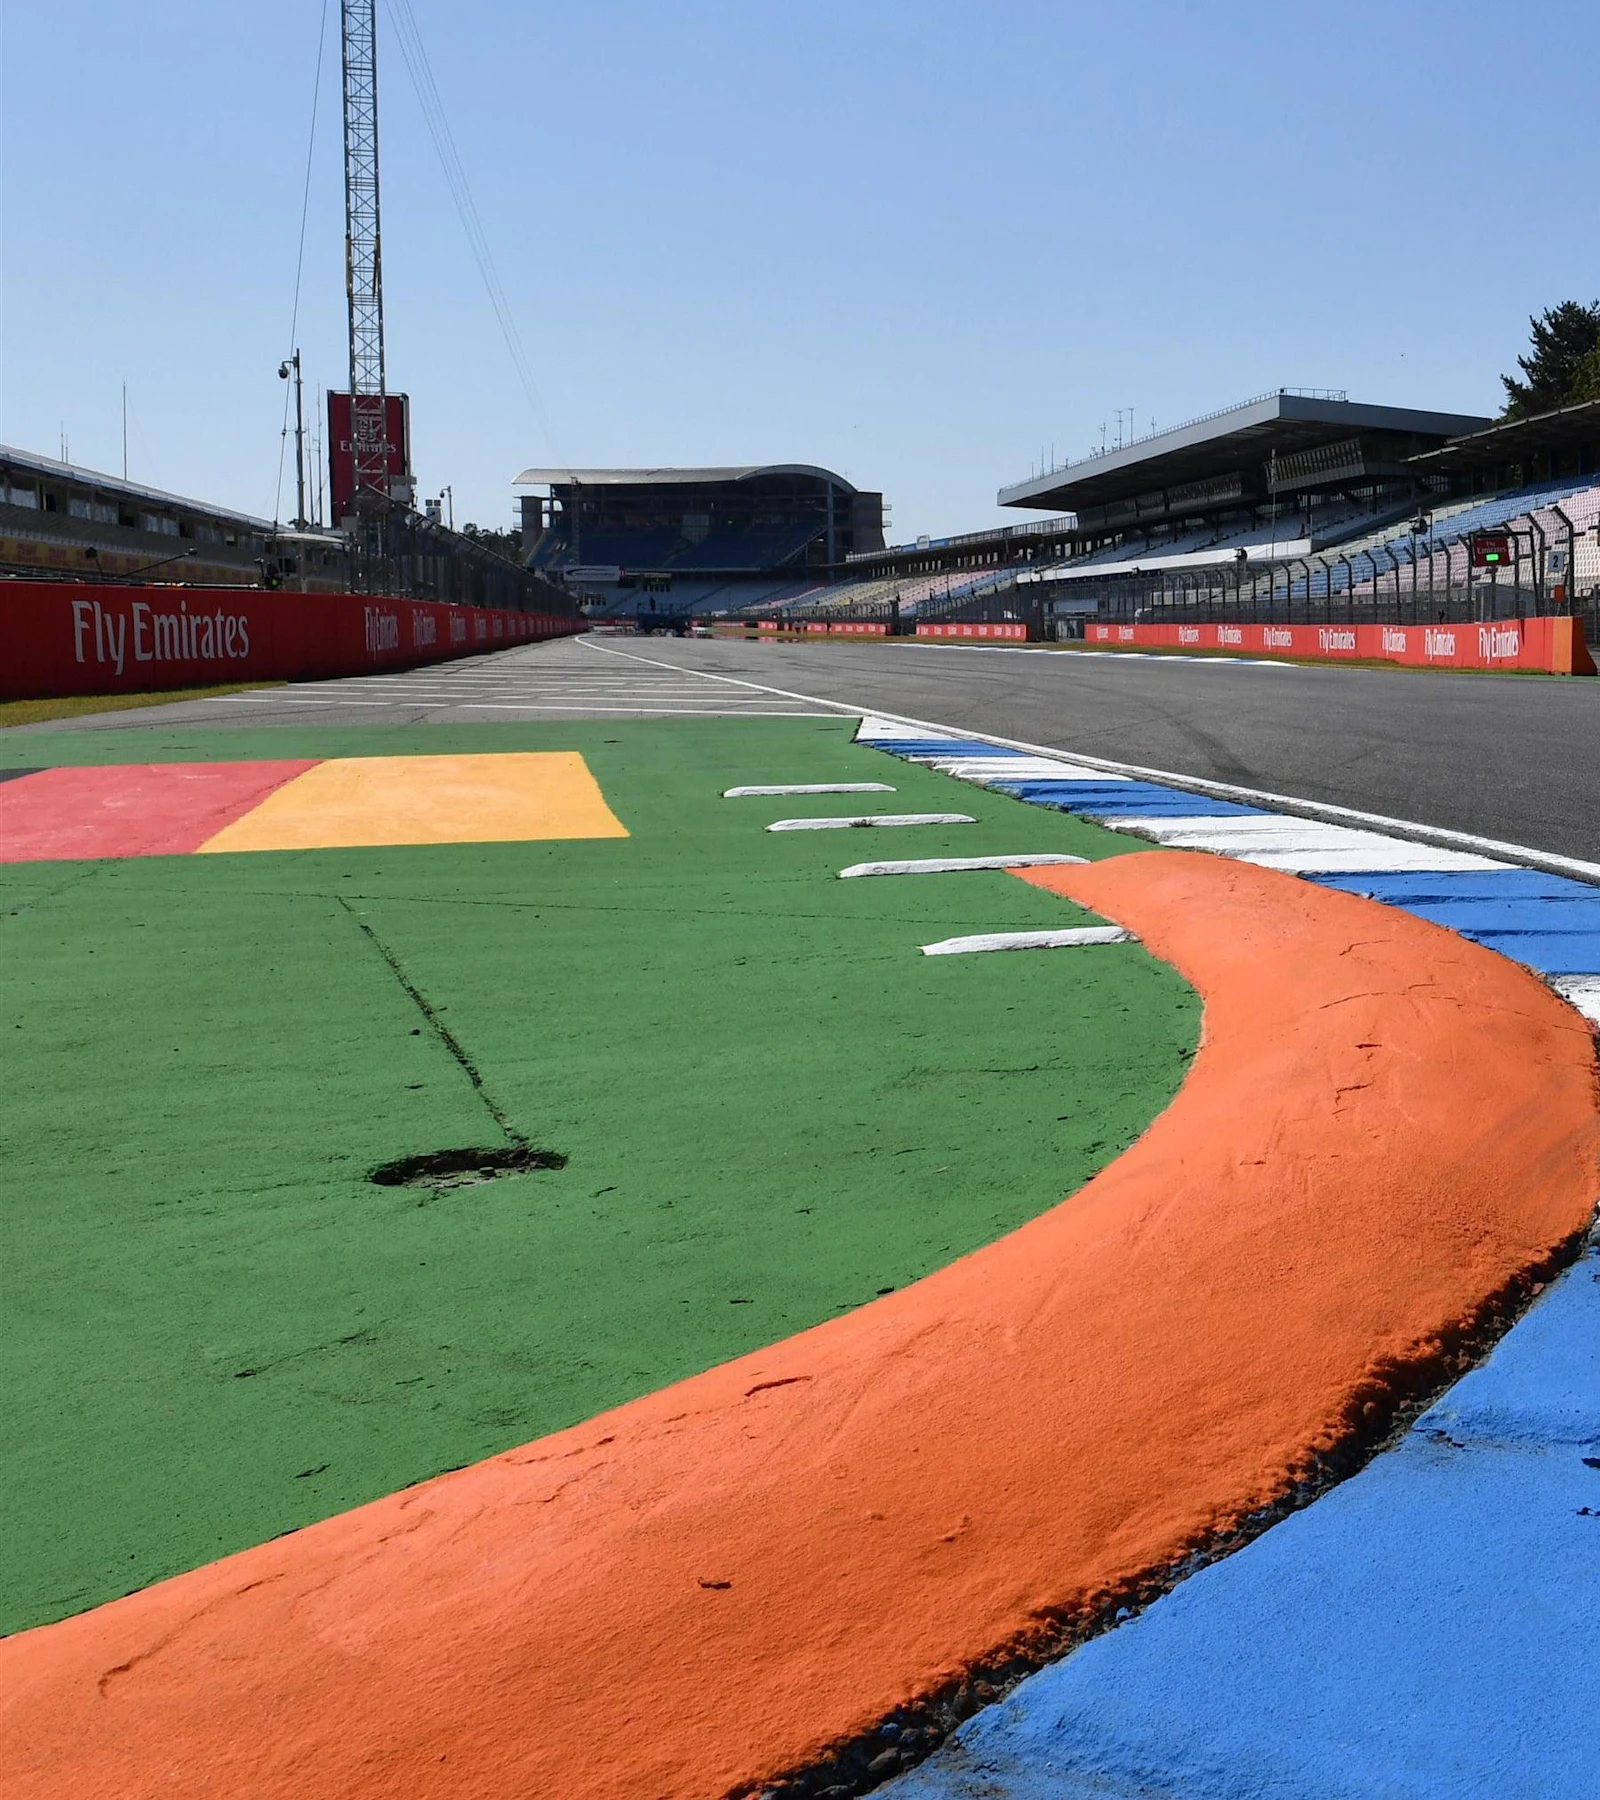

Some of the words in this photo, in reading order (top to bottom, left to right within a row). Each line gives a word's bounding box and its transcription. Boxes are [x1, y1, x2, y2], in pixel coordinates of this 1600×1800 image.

[1552, 556, 1559, 568] 2
[71, 600, 126, 675] Fly
[132, 600, 250, 661] Emirates
[1263, 627, 1271, 650] Fly
[1271, 626, 1293, 647] Emirates
[1319, 627, 1329, 653] Fly
[1329, 627, 1356, 650] Emirates
[1389, 627, 1406, 652] Emirates
[1425, 629, 1433, 661] Fly
[1433, 627, 1455, 656] Emirates
[1479, 627, 1491, 664] Fly
[1491, 624, 1519, 658] Emirates
